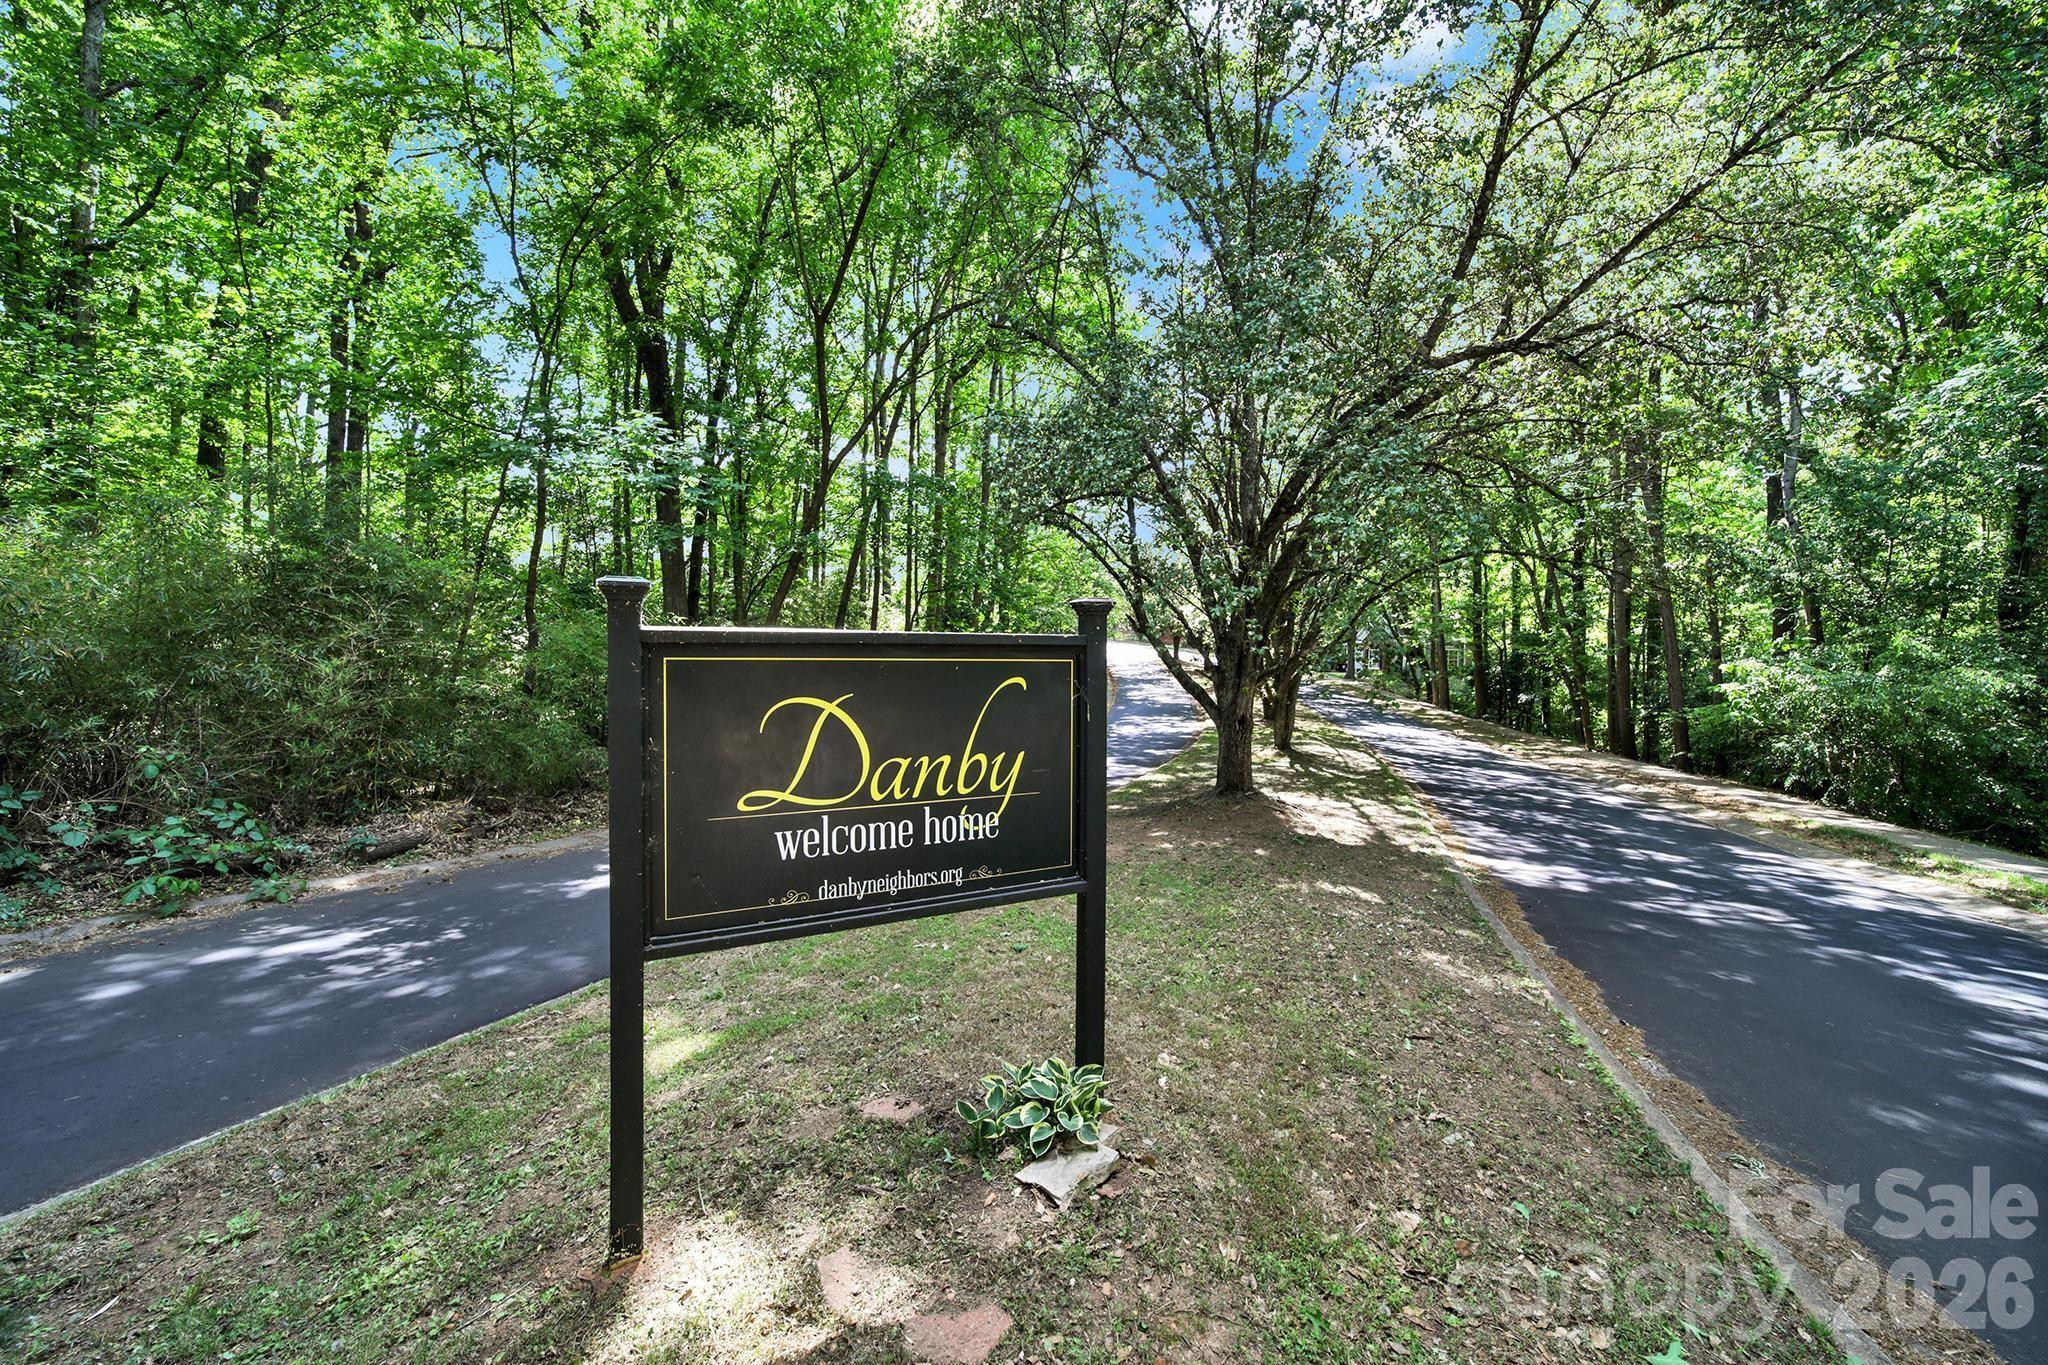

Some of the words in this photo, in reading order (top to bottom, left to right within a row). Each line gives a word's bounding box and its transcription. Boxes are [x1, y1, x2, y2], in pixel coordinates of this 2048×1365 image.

[737, 677, 1027, 830] Danby
[775, 815, 914, 861] welcome
[924, 806, 1000, 846] home
[818, 866, 963, 901] danbyneighbors.org
